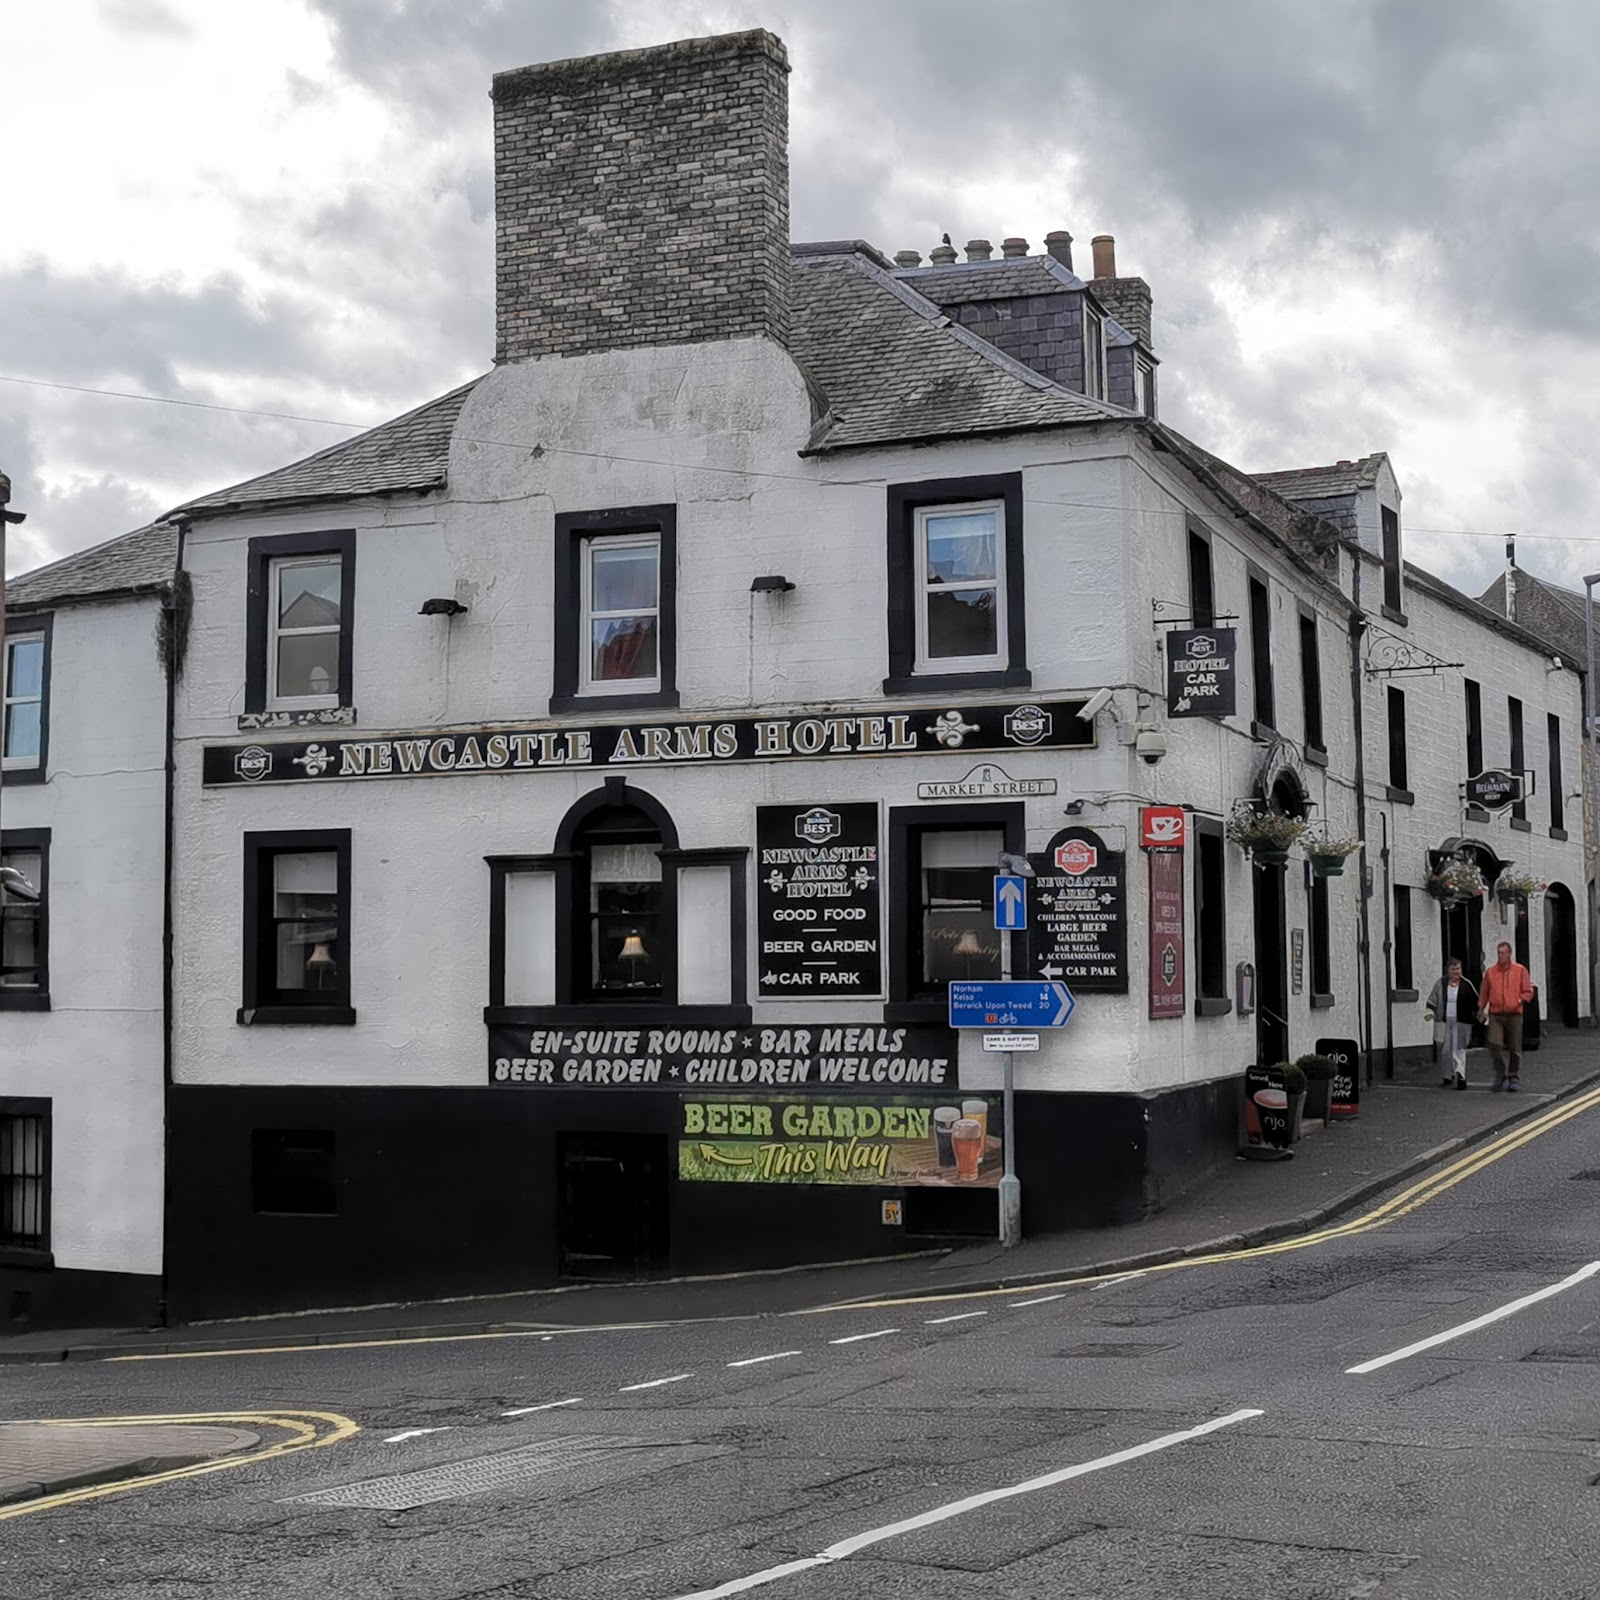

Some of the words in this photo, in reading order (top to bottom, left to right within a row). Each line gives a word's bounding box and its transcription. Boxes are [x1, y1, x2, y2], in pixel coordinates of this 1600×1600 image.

[1173, 658, 1230, 673] HOTEL
[1186, 673, 1217, 684] CAR
[1183, 685, 1220, 697] PARK
[1012, 718, 1046, 731] BEST
[339, 731, 593, 776] NEWCASTLE
[608, 724, 739, 764] ARMS
[754, 715, 918, 756] HOTEL
[241, 757, 267, 769] BEST
[927, 783, 986, 796] MARKET
[993, 781, 1045, 794] STREET
[1475, 783, 1511, 793] BELHAVEN
[804, 823, 834, 834] BEST
[762, 846, 877, 864] NEWCASTLE
[1061, 852, 1091, 863] BEST
[791, 865, 847, 881] ARMS
[1036, 876, 1117, 888] NEWCASTLE
[786, 882, 852, 898] HOTEL
[1056, 888, 1097, 900] ARMS
[1054, 900, 1101, 911] HOTEL
[773, 909, 817, 921] GOOD
[823, 908, 867, 921] FOOD
[1047, 923, 1079, 932] LARGE
[1082, 923, 1108, 932] BEER
[1057, 933, 1097, 942] GARDEN
[763, 941, 804, 953] BEER
[811, 940, 876, 952] GARDEN
[1054, 944, 1070, 952] BAR
[1072, 944, 1100, 952] MEALS
[1066, 966, 1087, 976] CAR
[1090, 966, 1117, 976] PARK
[779, 972, 813, 985] CAR
[820, 972, 860, 984] PARK
[1043, 984, 1050, 992] 9
[953, 993, 975, 1001] Kelso
[1039, 993, 1049, 1001] 14
[985, 1002, 1006, 1011] Upon
[530, 1030, 641, 1054] EN-SUITE
[648, 1030, 737, 1055] ROOMS
[760, 1029, 811, 1055] BAR
[819, 1028, 907, 1052] MEALS
[495, 1058, 555, 1084] BEER
[562, 1059, 662, 1084] GARDEN
[685, 1058, 811, 1084] CHILDREN
[819, 1058, 948, 1083] WELCOME
[1268, 1081, 1284, 1089] Here
[684, 1103, 773, 1136] BEER
[782, 1105, 930, 1139] GARDEN
[759, 1142, 817, 1178] This
[824, 1136, 890, 1177] Way
